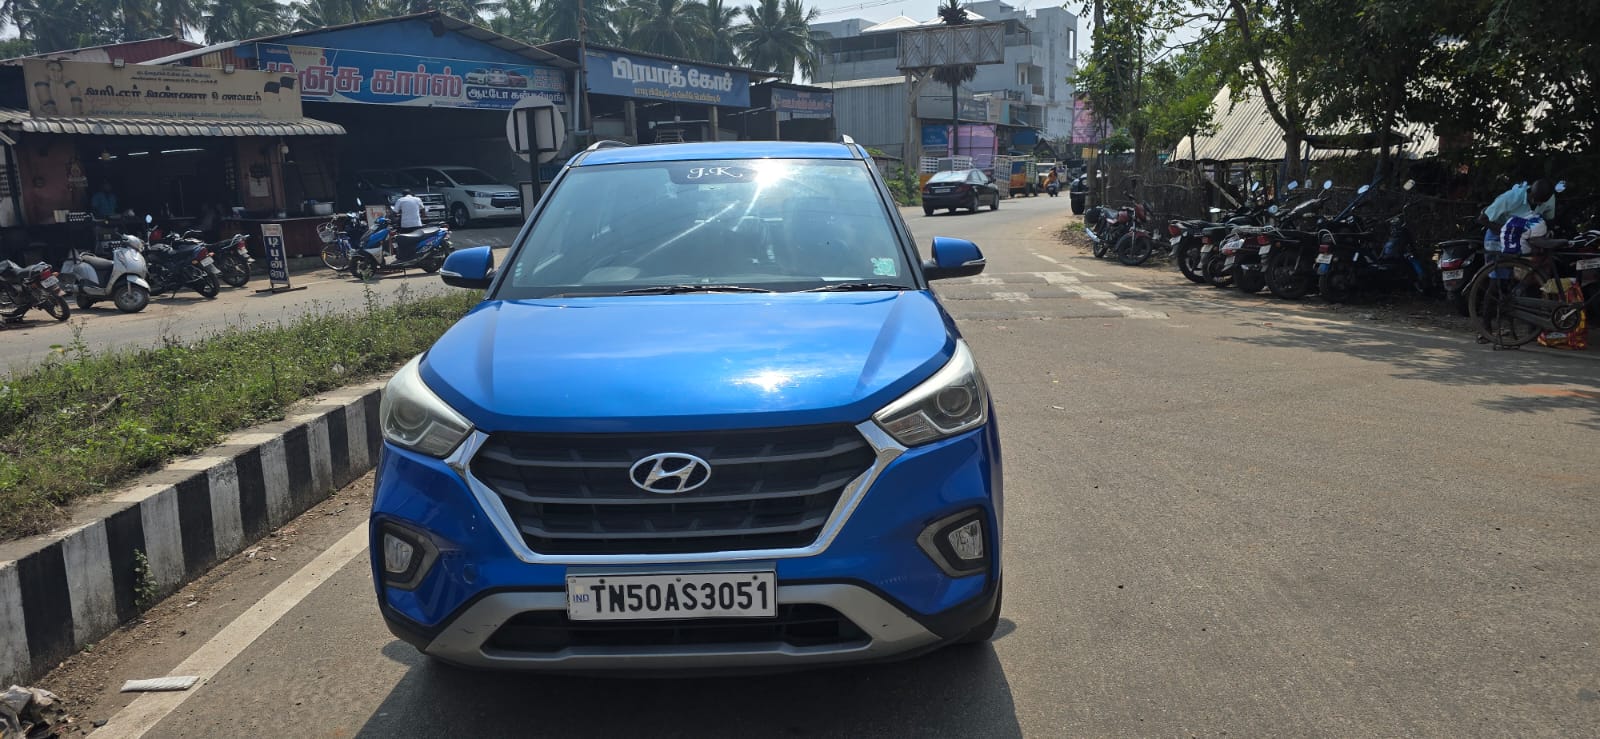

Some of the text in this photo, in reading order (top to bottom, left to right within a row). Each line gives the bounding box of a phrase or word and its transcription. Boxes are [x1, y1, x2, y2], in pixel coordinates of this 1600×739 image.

[371, 64, 463, 98] கார்ஸ்
[611, 57, 734, 92] பிரபாத் கோச்
[572, 581, 769, 613] IND TN50AS3051
